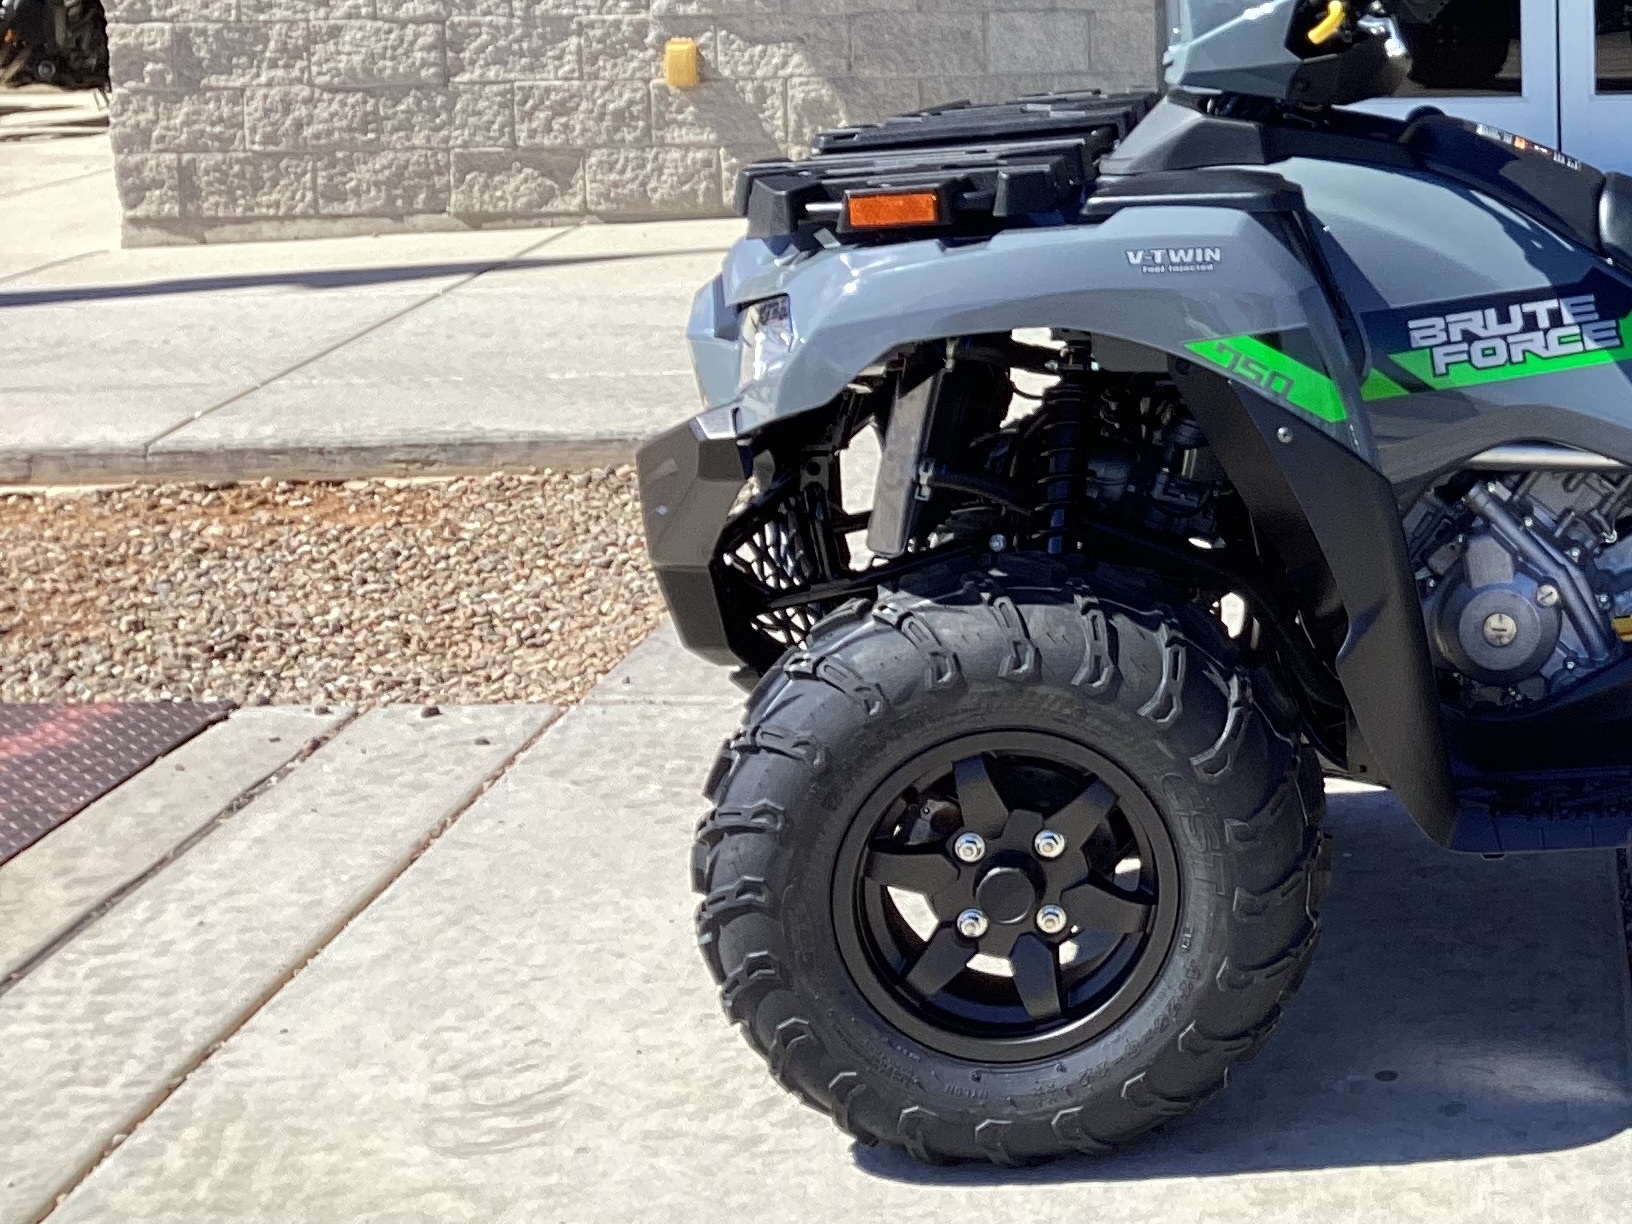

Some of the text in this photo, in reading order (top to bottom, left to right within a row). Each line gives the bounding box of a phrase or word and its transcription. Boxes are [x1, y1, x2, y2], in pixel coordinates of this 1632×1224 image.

[1125, 247, 1221, 265] V-TWIN
[1406, 293, 1600, 349] BRUTE
[1431, 319, 1622, 376] FORCE
[1215, 341, 1295, 399] 750
